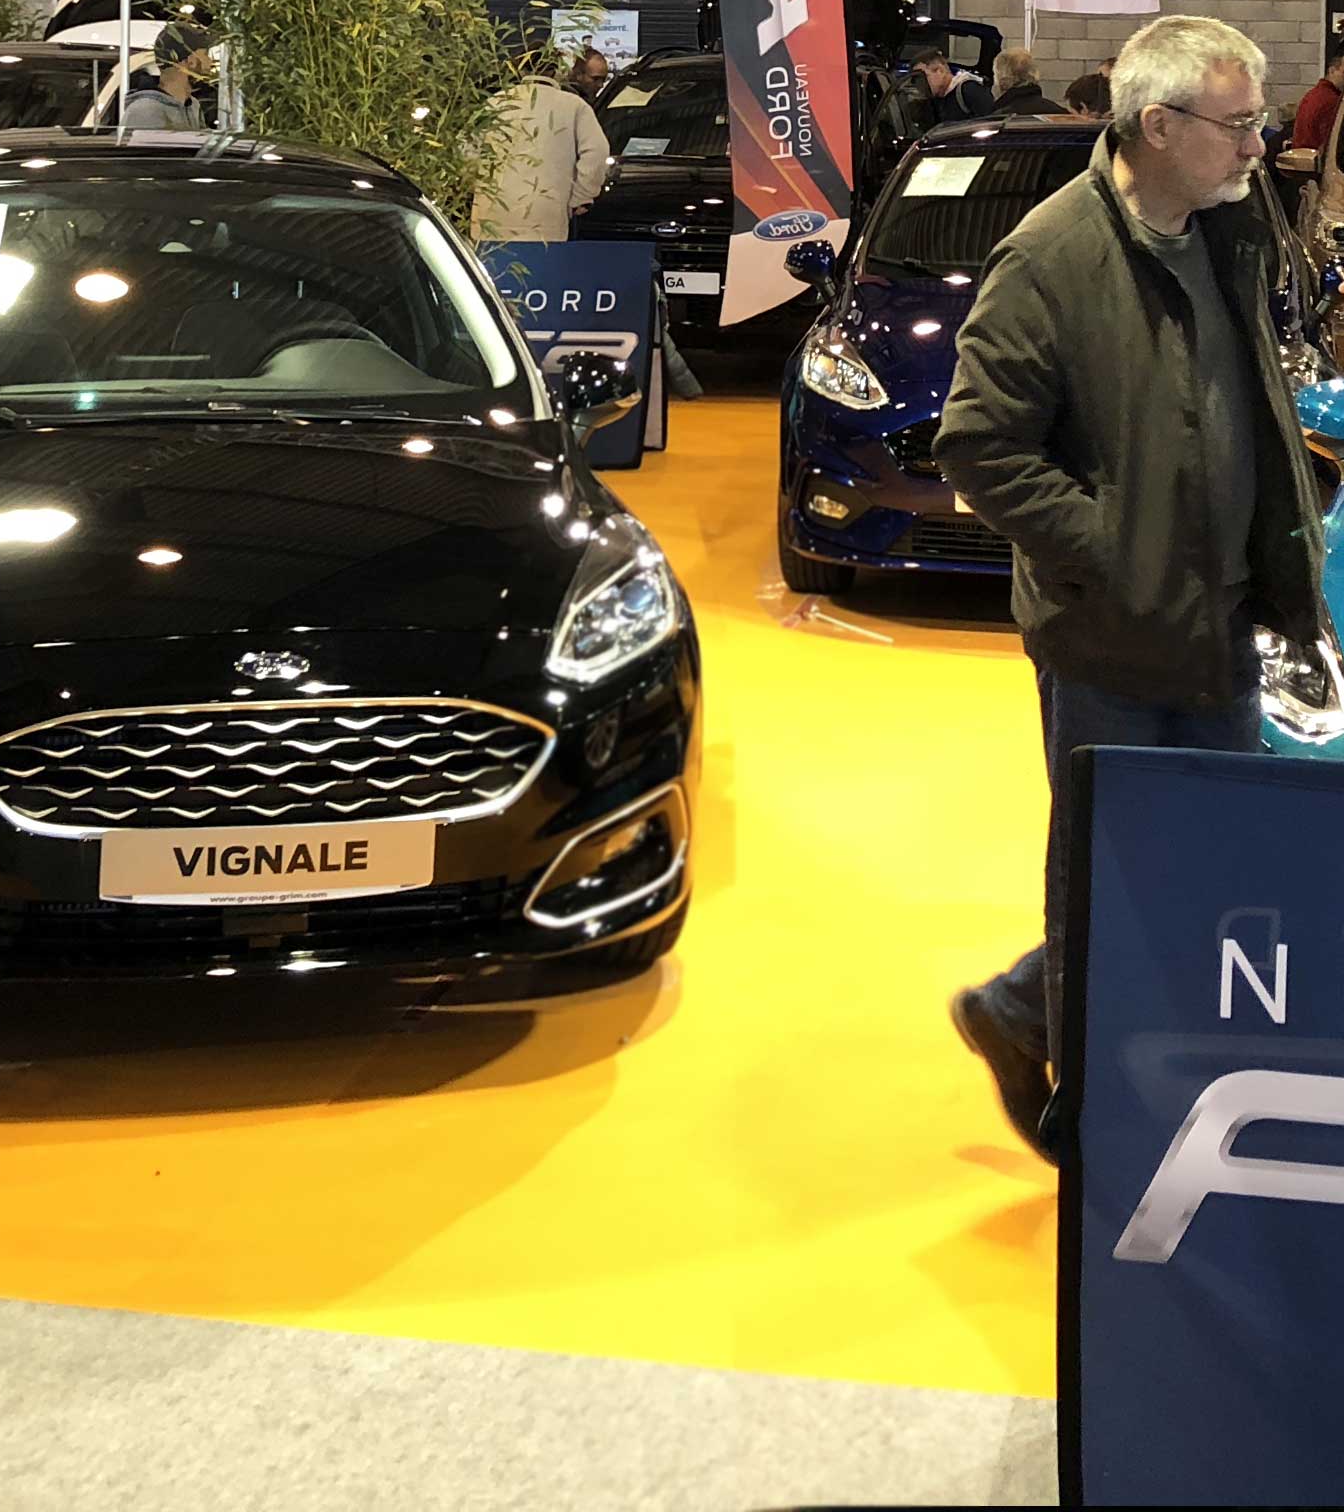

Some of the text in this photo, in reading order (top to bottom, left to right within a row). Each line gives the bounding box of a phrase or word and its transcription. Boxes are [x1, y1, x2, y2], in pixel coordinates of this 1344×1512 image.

[665, 276, 685, 289] GA
[172, 840, 369, 877] VIGNALE
[209, 891, 328, 903] www.groupe-grim.com
